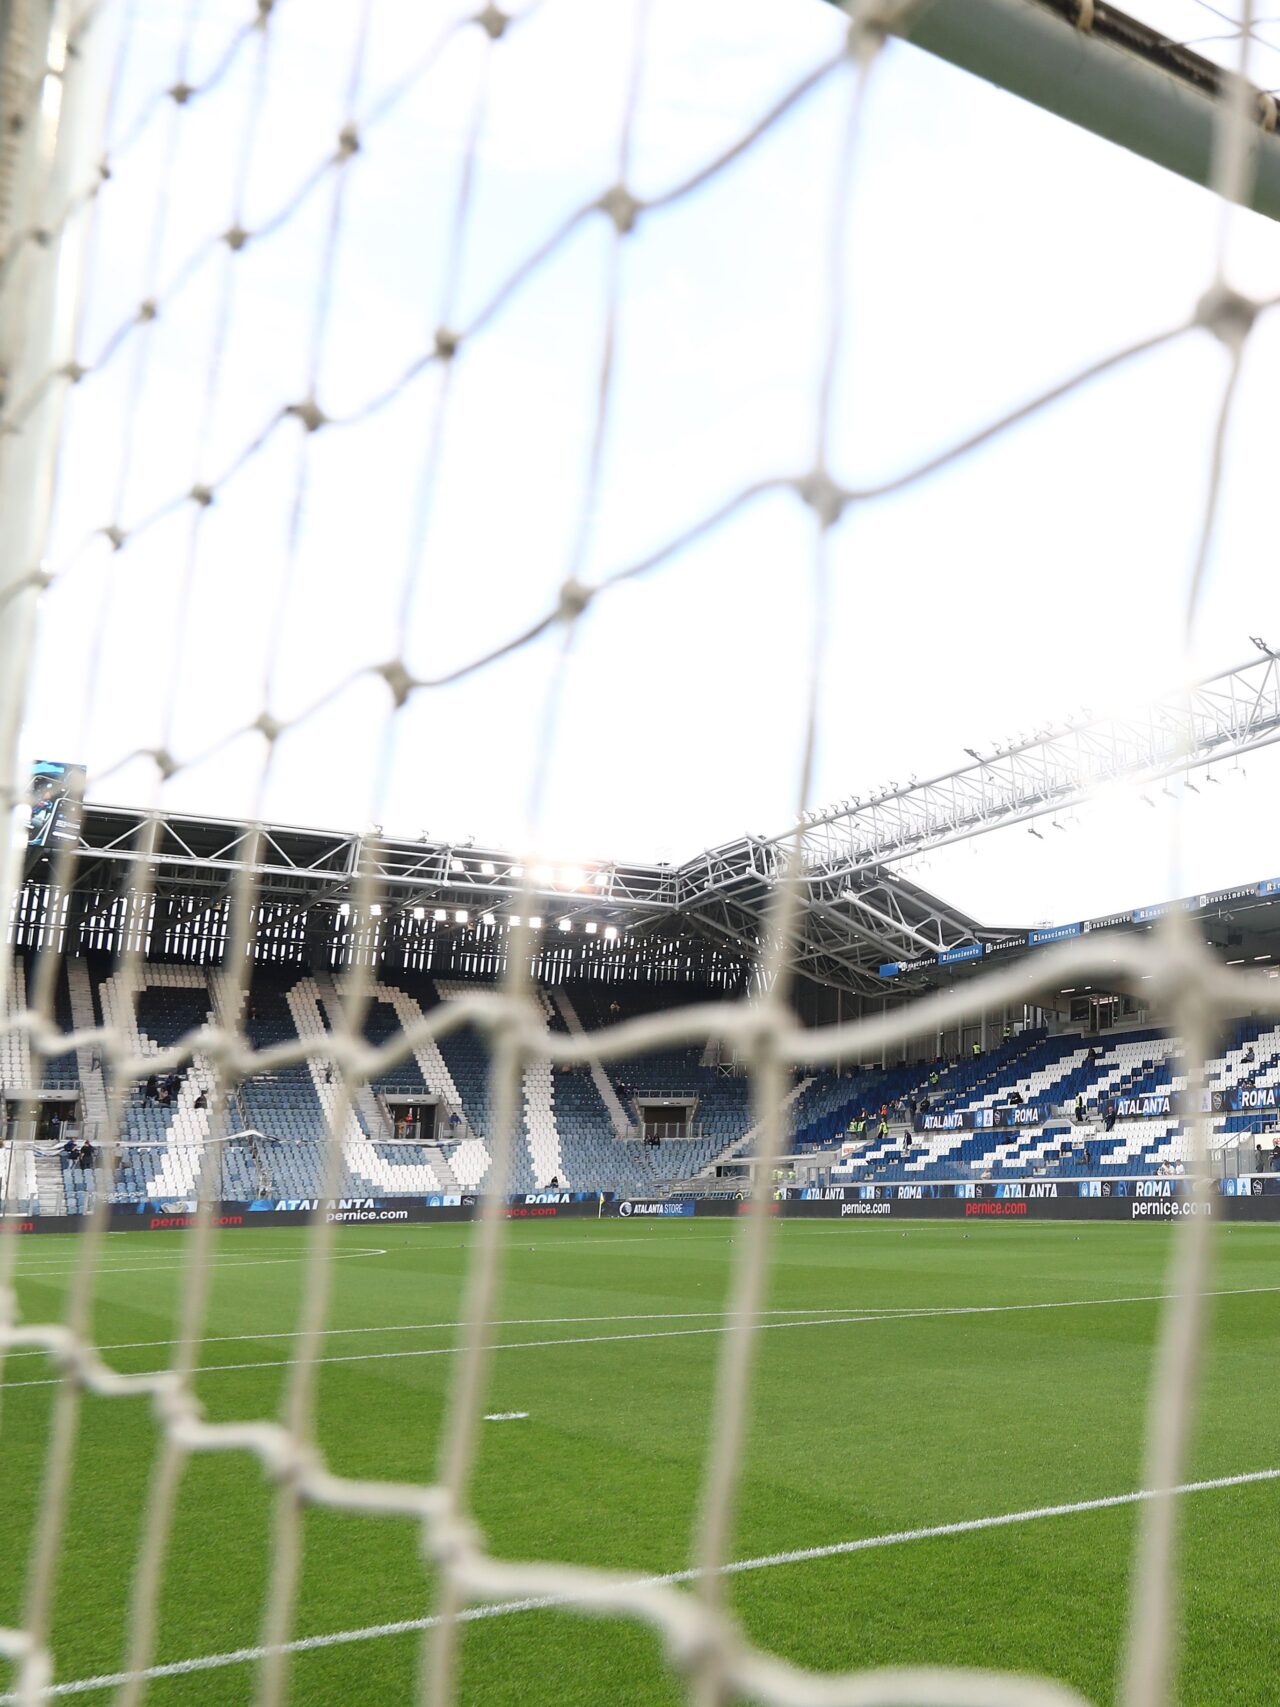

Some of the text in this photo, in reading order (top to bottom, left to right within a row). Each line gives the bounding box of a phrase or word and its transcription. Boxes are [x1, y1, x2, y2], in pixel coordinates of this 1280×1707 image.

[1199, 887, 1255, 907] Rinascimento
[1116, 1089, 1275, 1116] ATALANTA ROMA
[923, 1108, 1039, 1129] ATALANTA ROMA
[806, 1187, 845, 1200] ATALANTA
[898, 1186, 922, 1199] ROMA
[1003, 1183, 1058, 1198] ATALANTA
[1136, 1180, 1171, 1197] ROMA
[633, 1203, 683, 1214] ATALANTA STORE
[841, 1201, 891, 1216] pernice.com
[965, 1200, 1027, 1216] pernice.com
[326, 1210, 408, 1223] pernice.com
